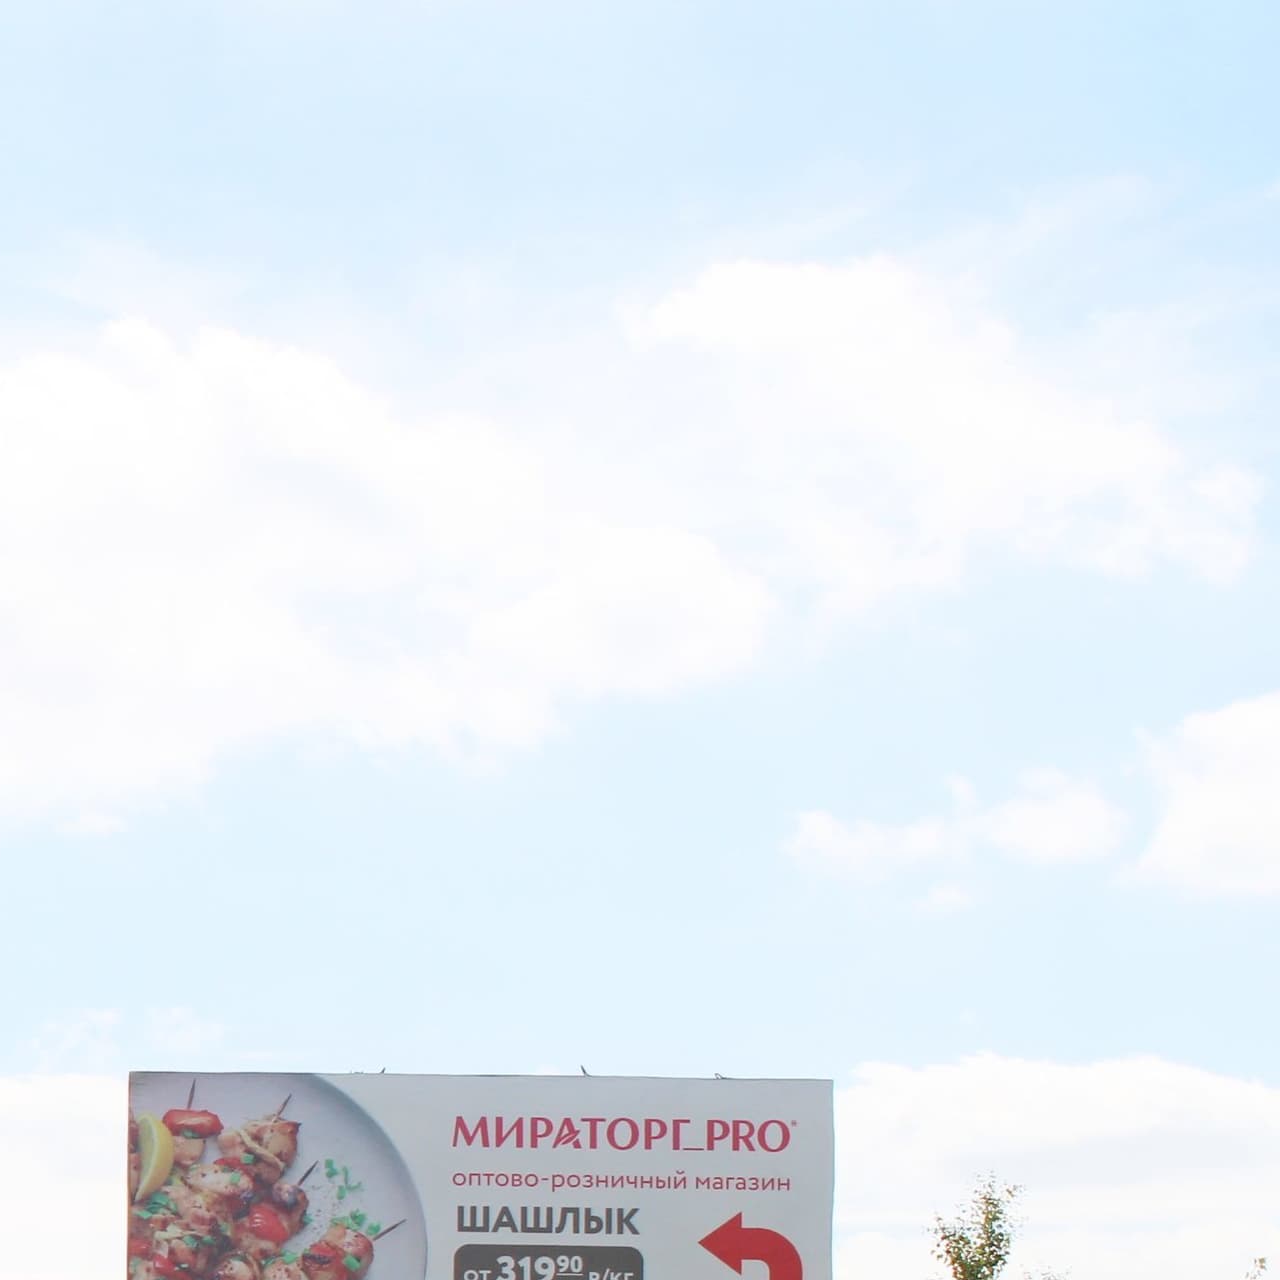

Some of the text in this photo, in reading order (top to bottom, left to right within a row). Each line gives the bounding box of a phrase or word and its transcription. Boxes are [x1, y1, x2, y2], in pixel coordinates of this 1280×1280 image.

[452, 1170, 791, 1192] оптово-розничный магазин
[456, 1205, 641, 1235] ШАШЛЫК
